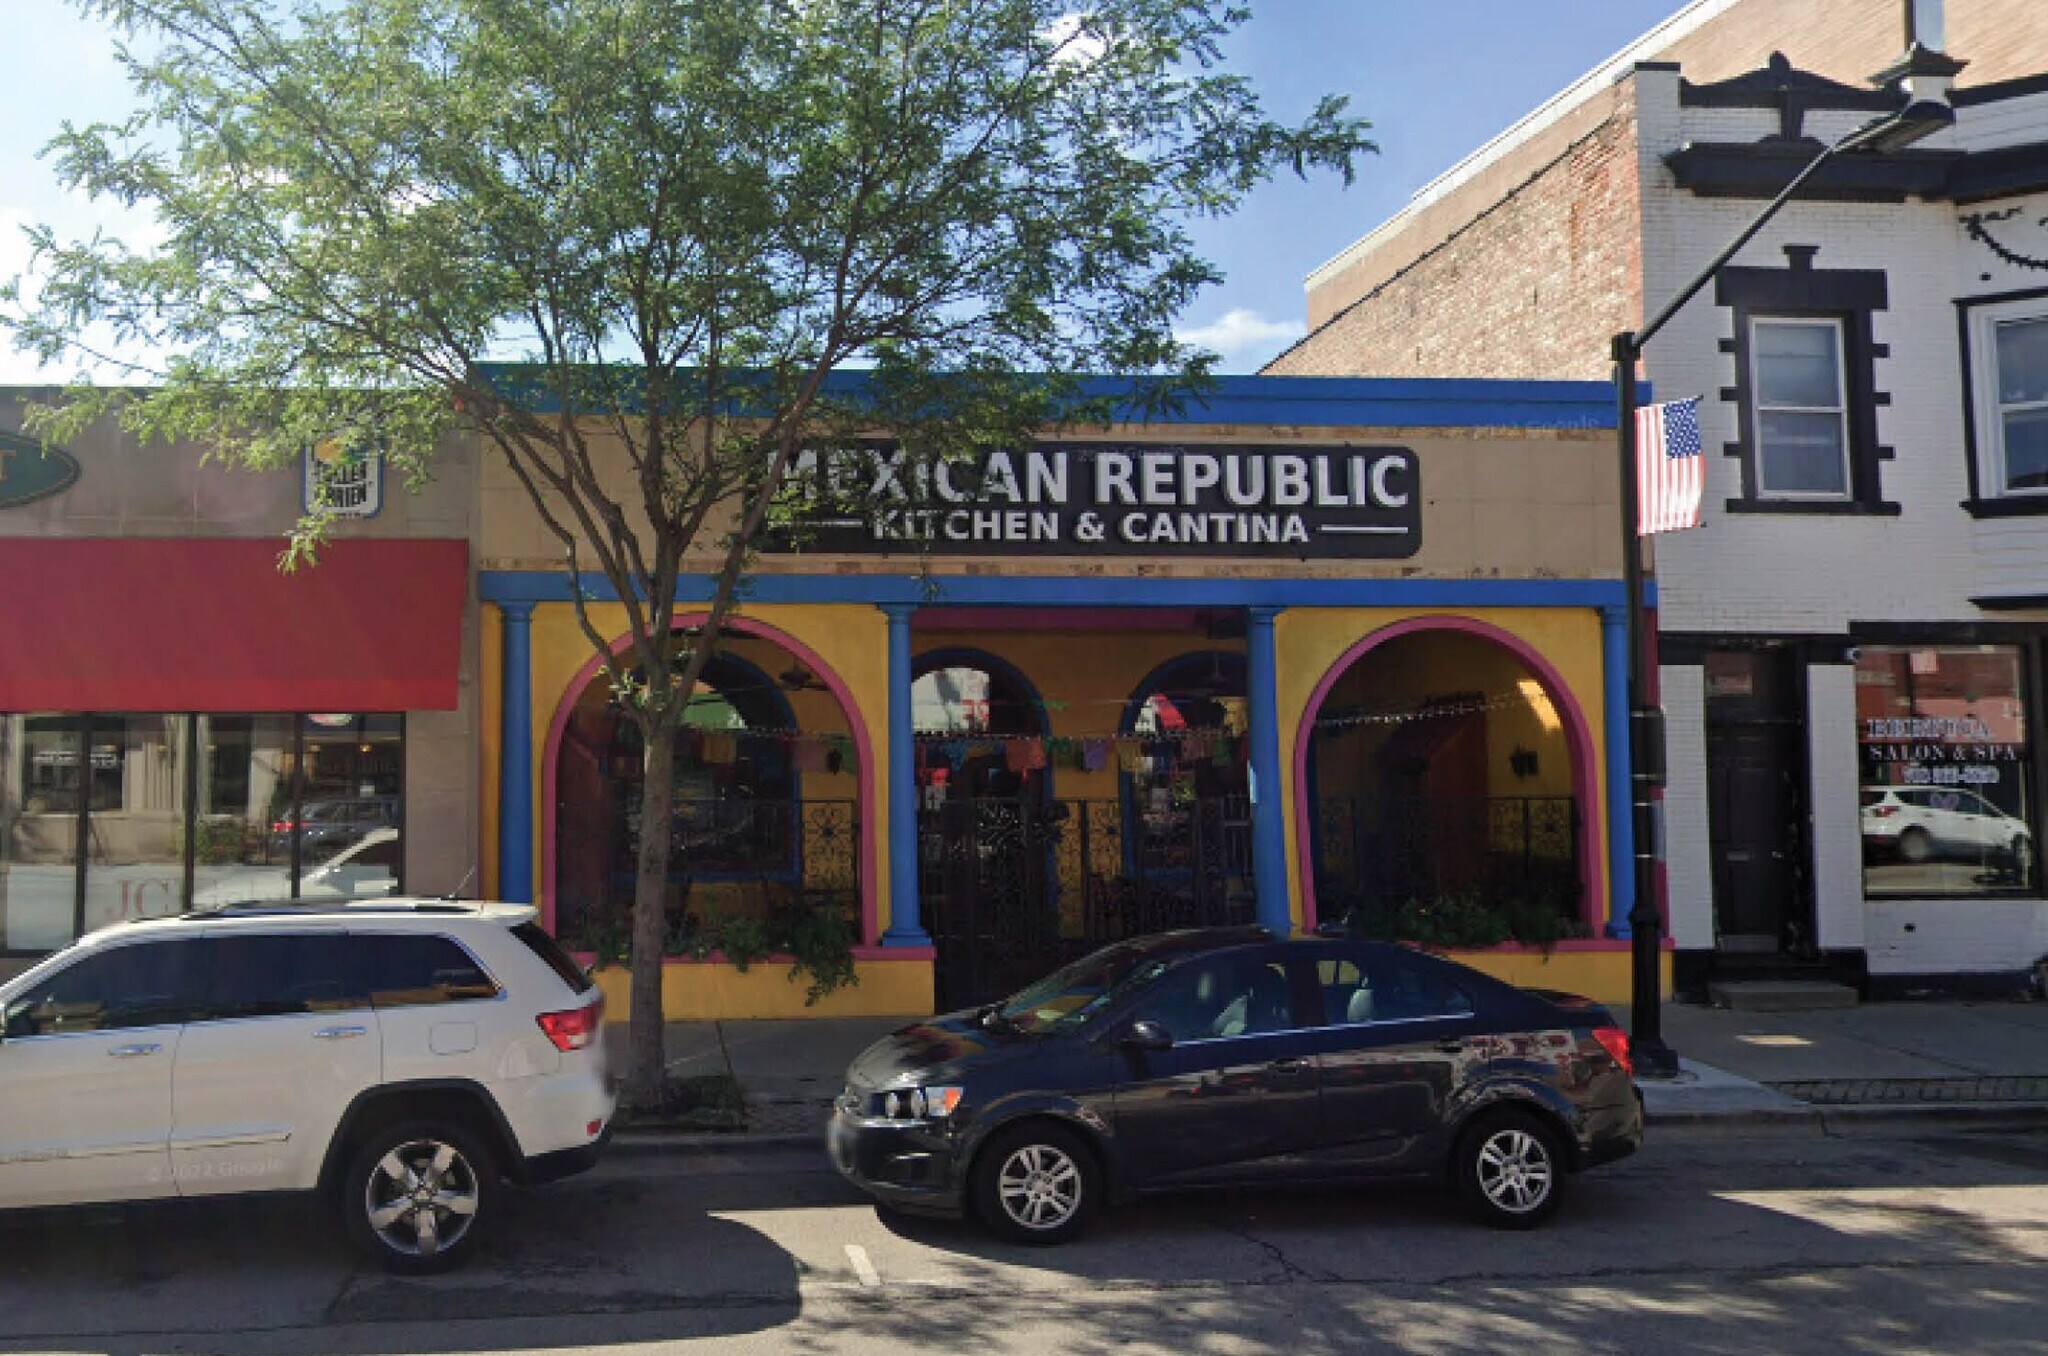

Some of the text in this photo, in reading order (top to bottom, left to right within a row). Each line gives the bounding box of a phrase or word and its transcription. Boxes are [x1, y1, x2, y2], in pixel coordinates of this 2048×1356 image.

[764, 449, 1410, 507] MEXICAN REPUBLIC
[872, 508, 1309, 543] KITCHEN & CANTINA
[1869, 744, 2017, 760] SALON & SPA
